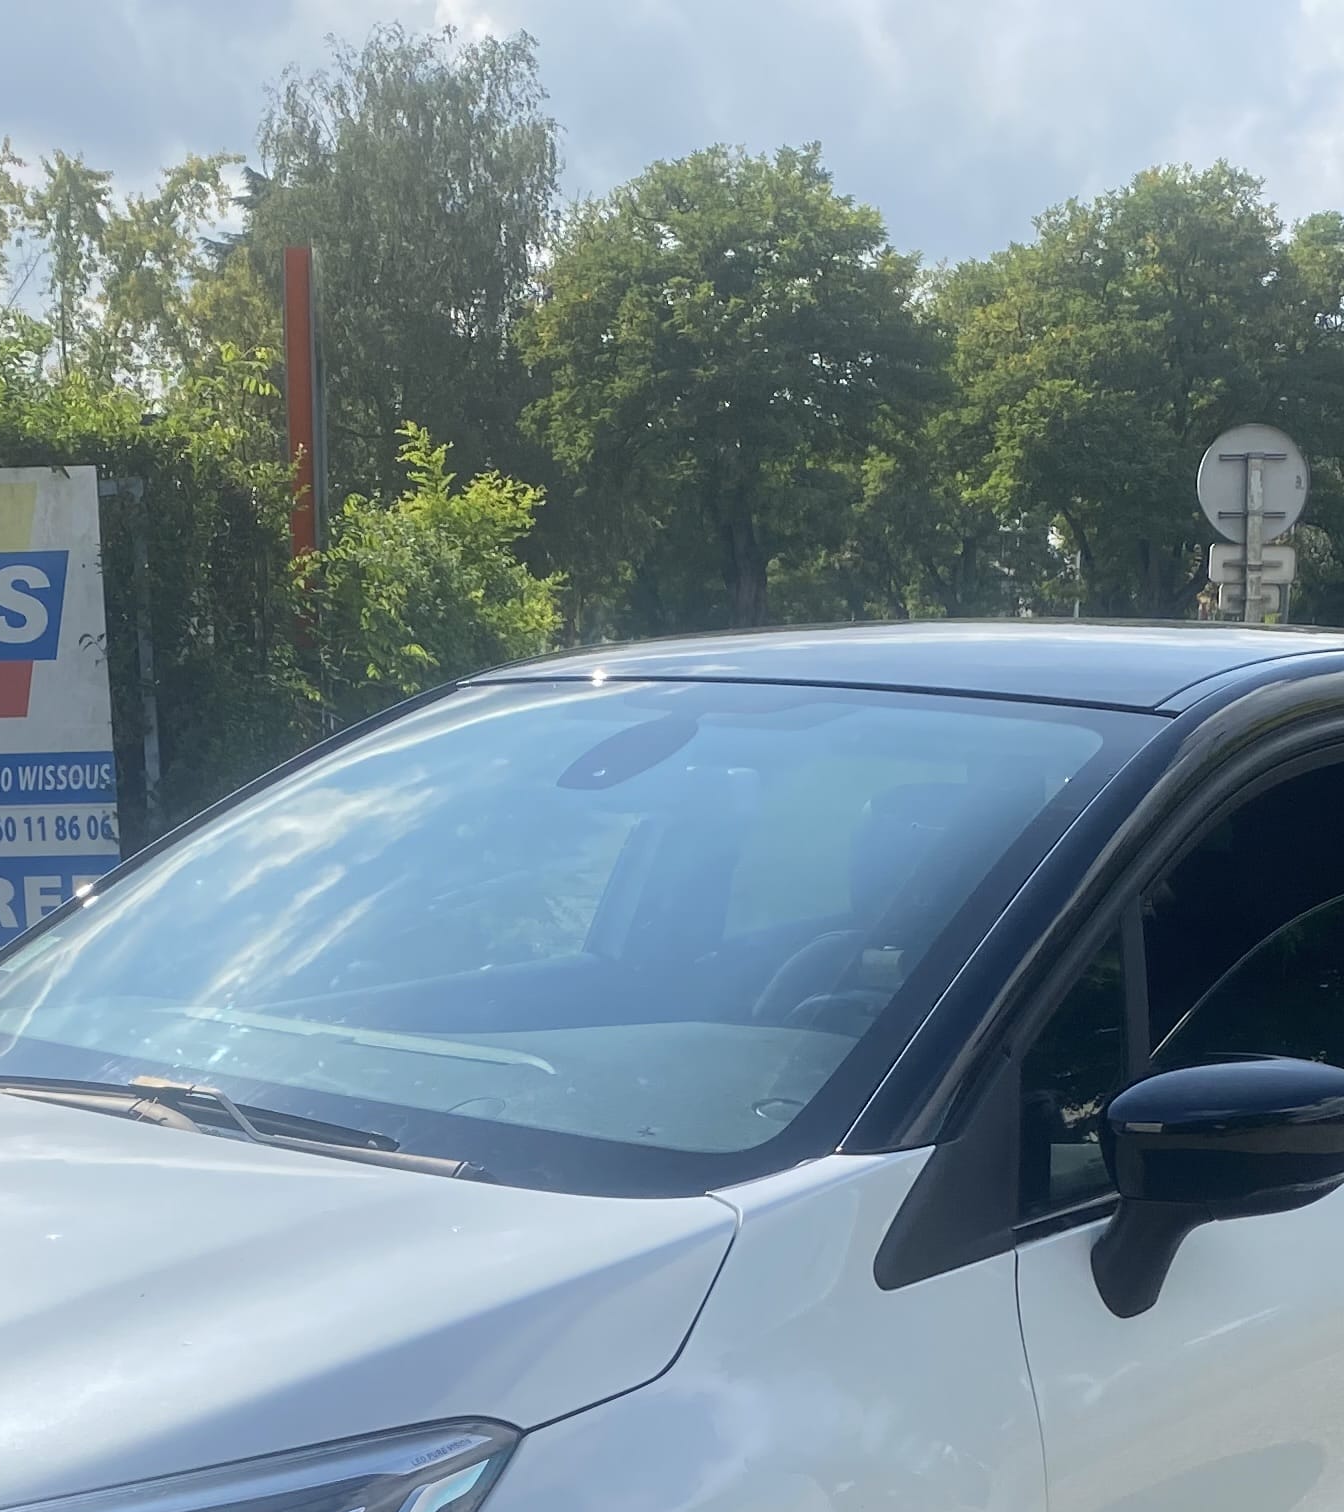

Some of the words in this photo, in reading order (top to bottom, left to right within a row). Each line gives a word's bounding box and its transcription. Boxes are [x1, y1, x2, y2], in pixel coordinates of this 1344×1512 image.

[18, 763, 111, 792] WISSOUS
[23, 816, 47, 842] 11
[55, 815, 81, 841] 86
[86, 815, 114, 841] 06
